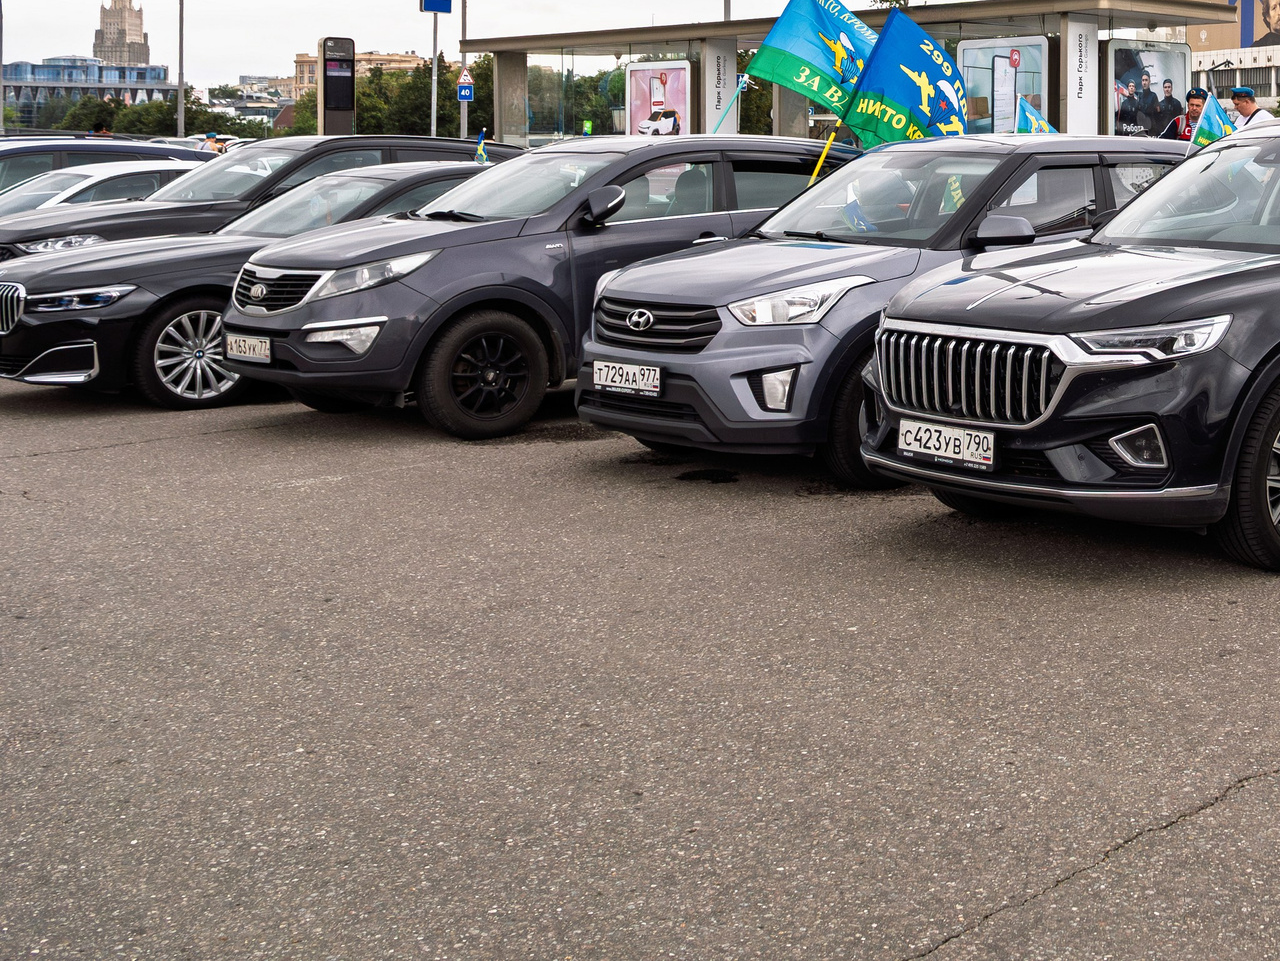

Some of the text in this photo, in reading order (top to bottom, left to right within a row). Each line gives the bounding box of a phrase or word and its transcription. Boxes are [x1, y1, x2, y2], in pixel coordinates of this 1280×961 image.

[840, 12, 879, 43] КРОМ
[920, 39, 952, 77] 299
[793, 65, 819, 92] ЗА
[856, 98, 907, 129] НИКТО
[259, 340, 267, 352] 77
[597, 365, 657, 386] Т729АА 977
[904, 426, 989, 455] С423УВ 790
[971, 451, 982, 459] RUS
